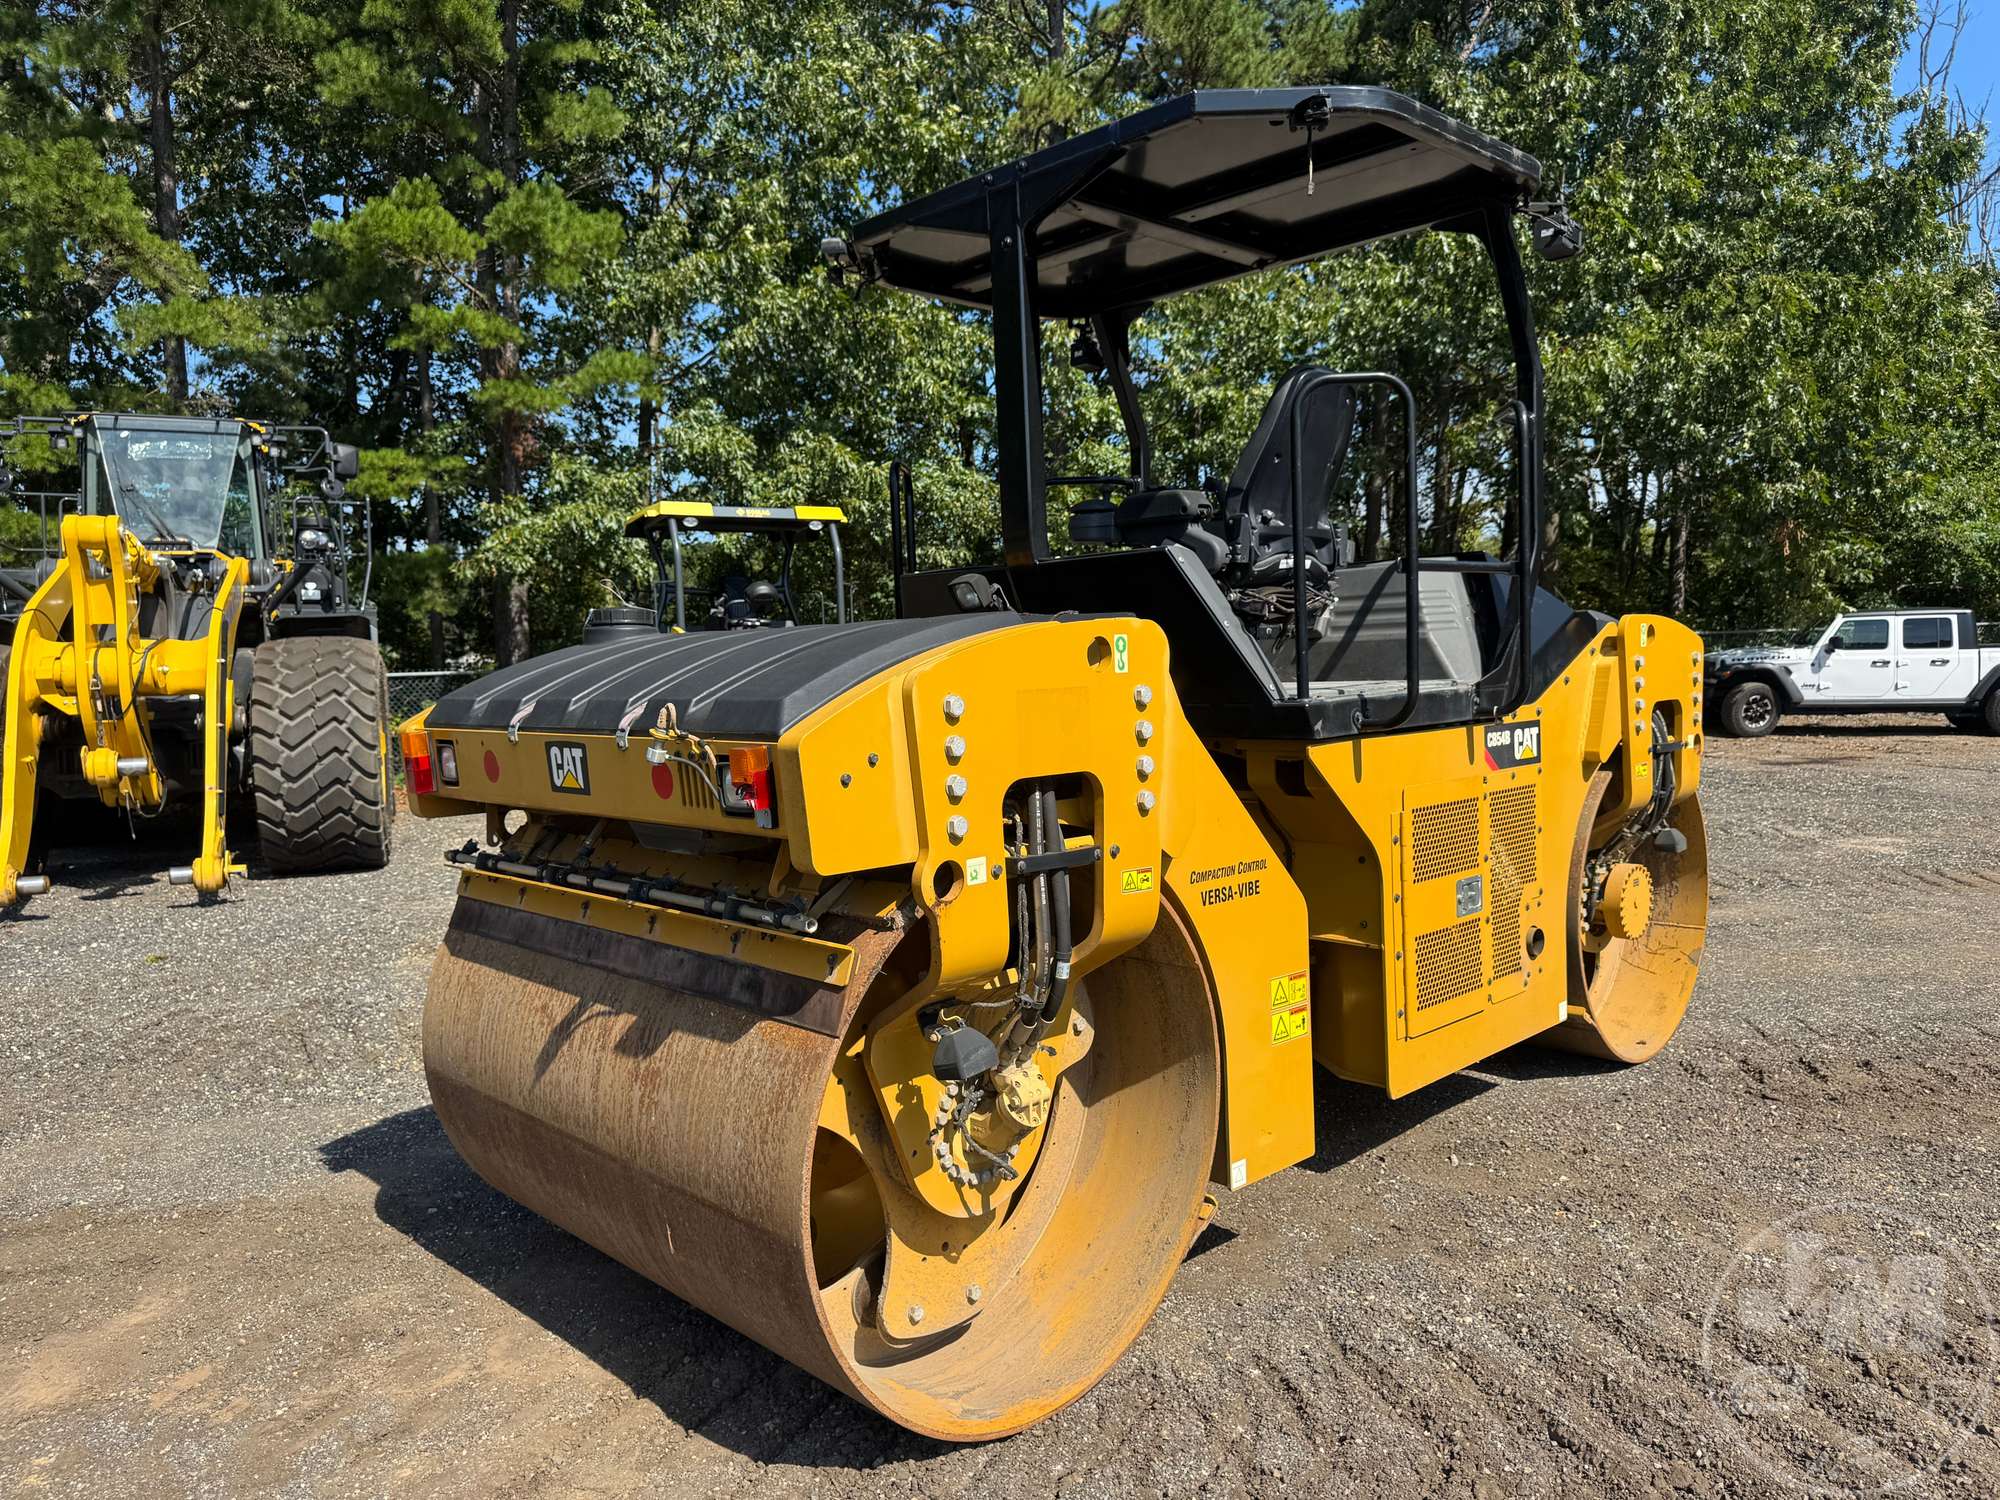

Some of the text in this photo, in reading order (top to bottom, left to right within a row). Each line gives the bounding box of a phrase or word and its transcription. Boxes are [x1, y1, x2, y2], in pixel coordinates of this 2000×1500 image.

[1487, 727, 1539, 760] CB54B CAT
[550, 746, 585, 789] CAT
[1190, 859, 1267, 884] COMPACTION CONTROL
[1201, 880, 1260, 907] VERSA-VIBE
